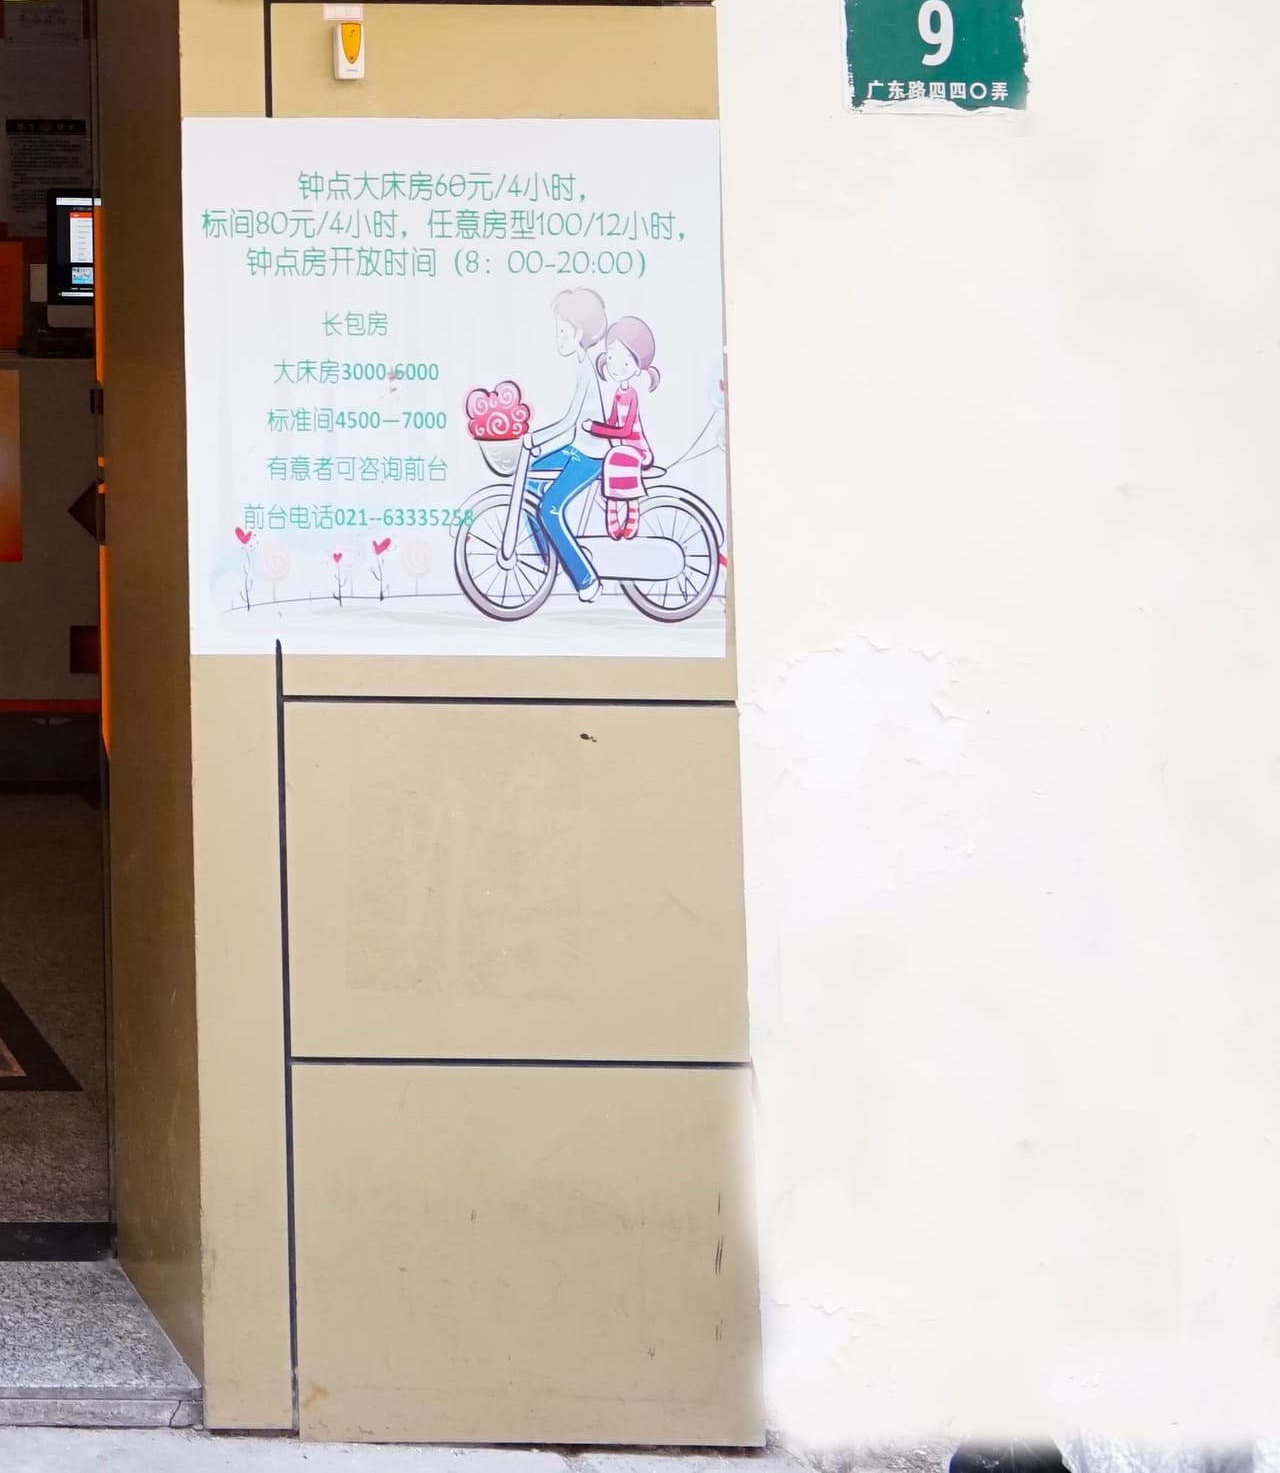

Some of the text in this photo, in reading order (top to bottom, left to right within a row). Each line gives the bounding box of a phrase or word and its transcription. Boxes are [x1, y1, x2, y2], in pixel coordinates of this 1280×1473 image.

[918, 0, 954, 66] 9
[321, 310, 389, 337] 长包房
[273, 359, 439, 384] 大床房3000-6000
[267, 455, 449, 482] 有意者可咨询前台
